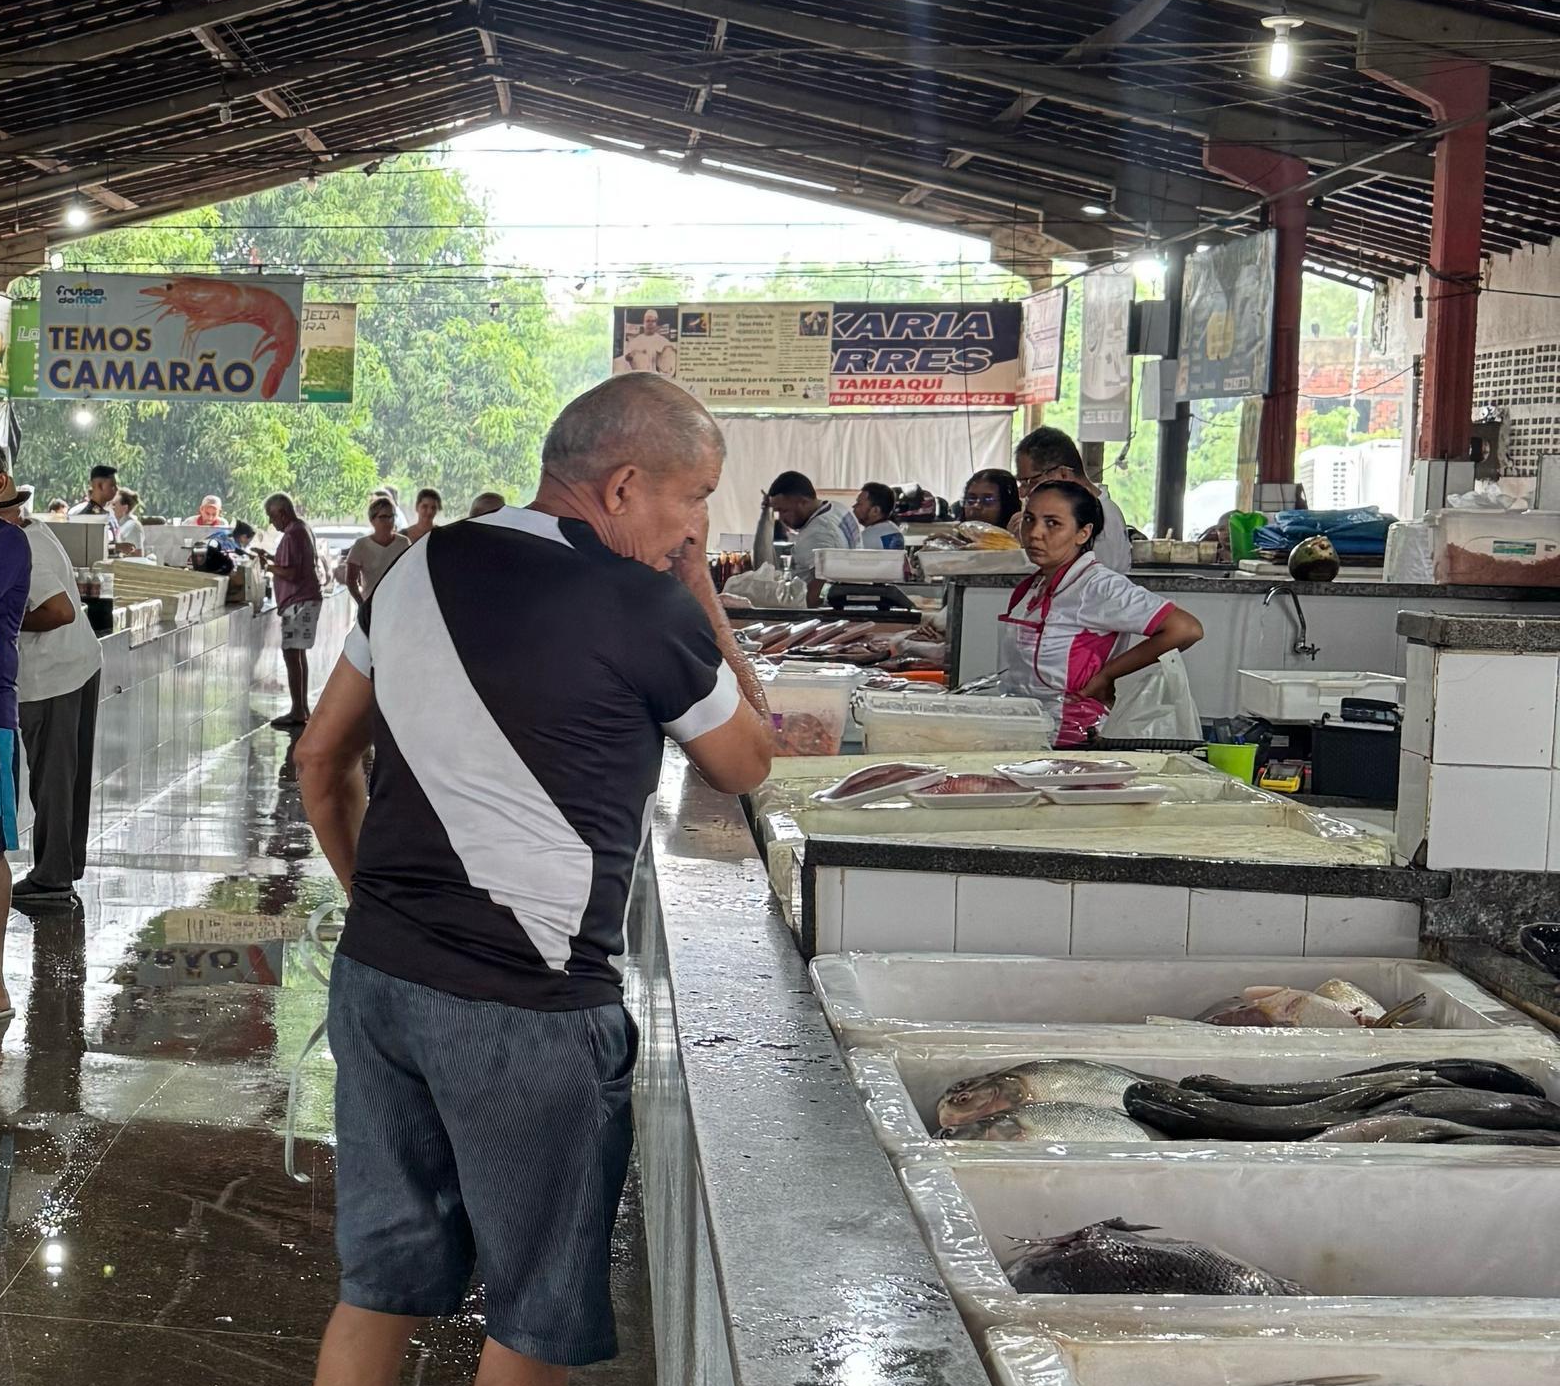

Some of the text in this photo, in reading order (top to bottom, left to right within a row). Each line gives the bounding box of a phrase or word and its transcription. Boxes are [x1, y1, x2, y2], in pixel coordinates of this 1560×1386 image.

[48, 326, 152, 352] TEMOS
[48, 351, 255, 393] CAMARÃO
[830, 347, 993, 375] RRES
[709, 387, 770, 396] Irmão Torres
